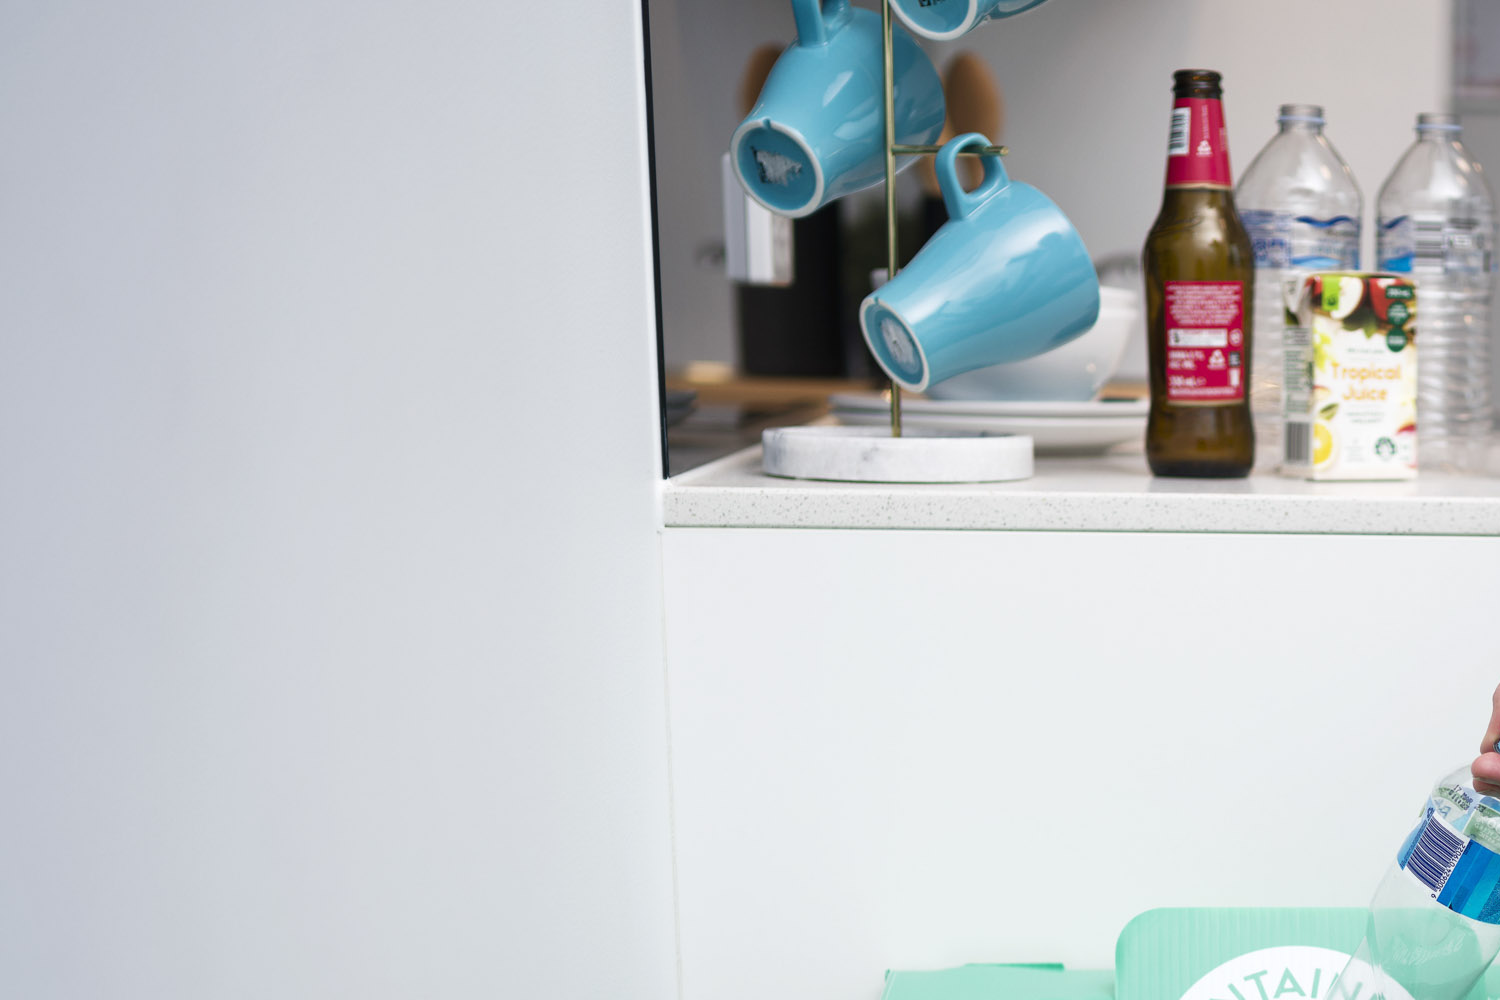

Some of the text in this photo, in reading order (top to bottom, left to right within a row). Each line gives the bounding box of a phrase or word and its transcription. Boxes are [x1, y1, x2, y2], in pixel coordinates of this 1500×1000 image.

[1331, 362, 1402, 384] Tropical
[1342, 385, 1388, 401] Juice
[1450, 844, 1466, 867] 019022
